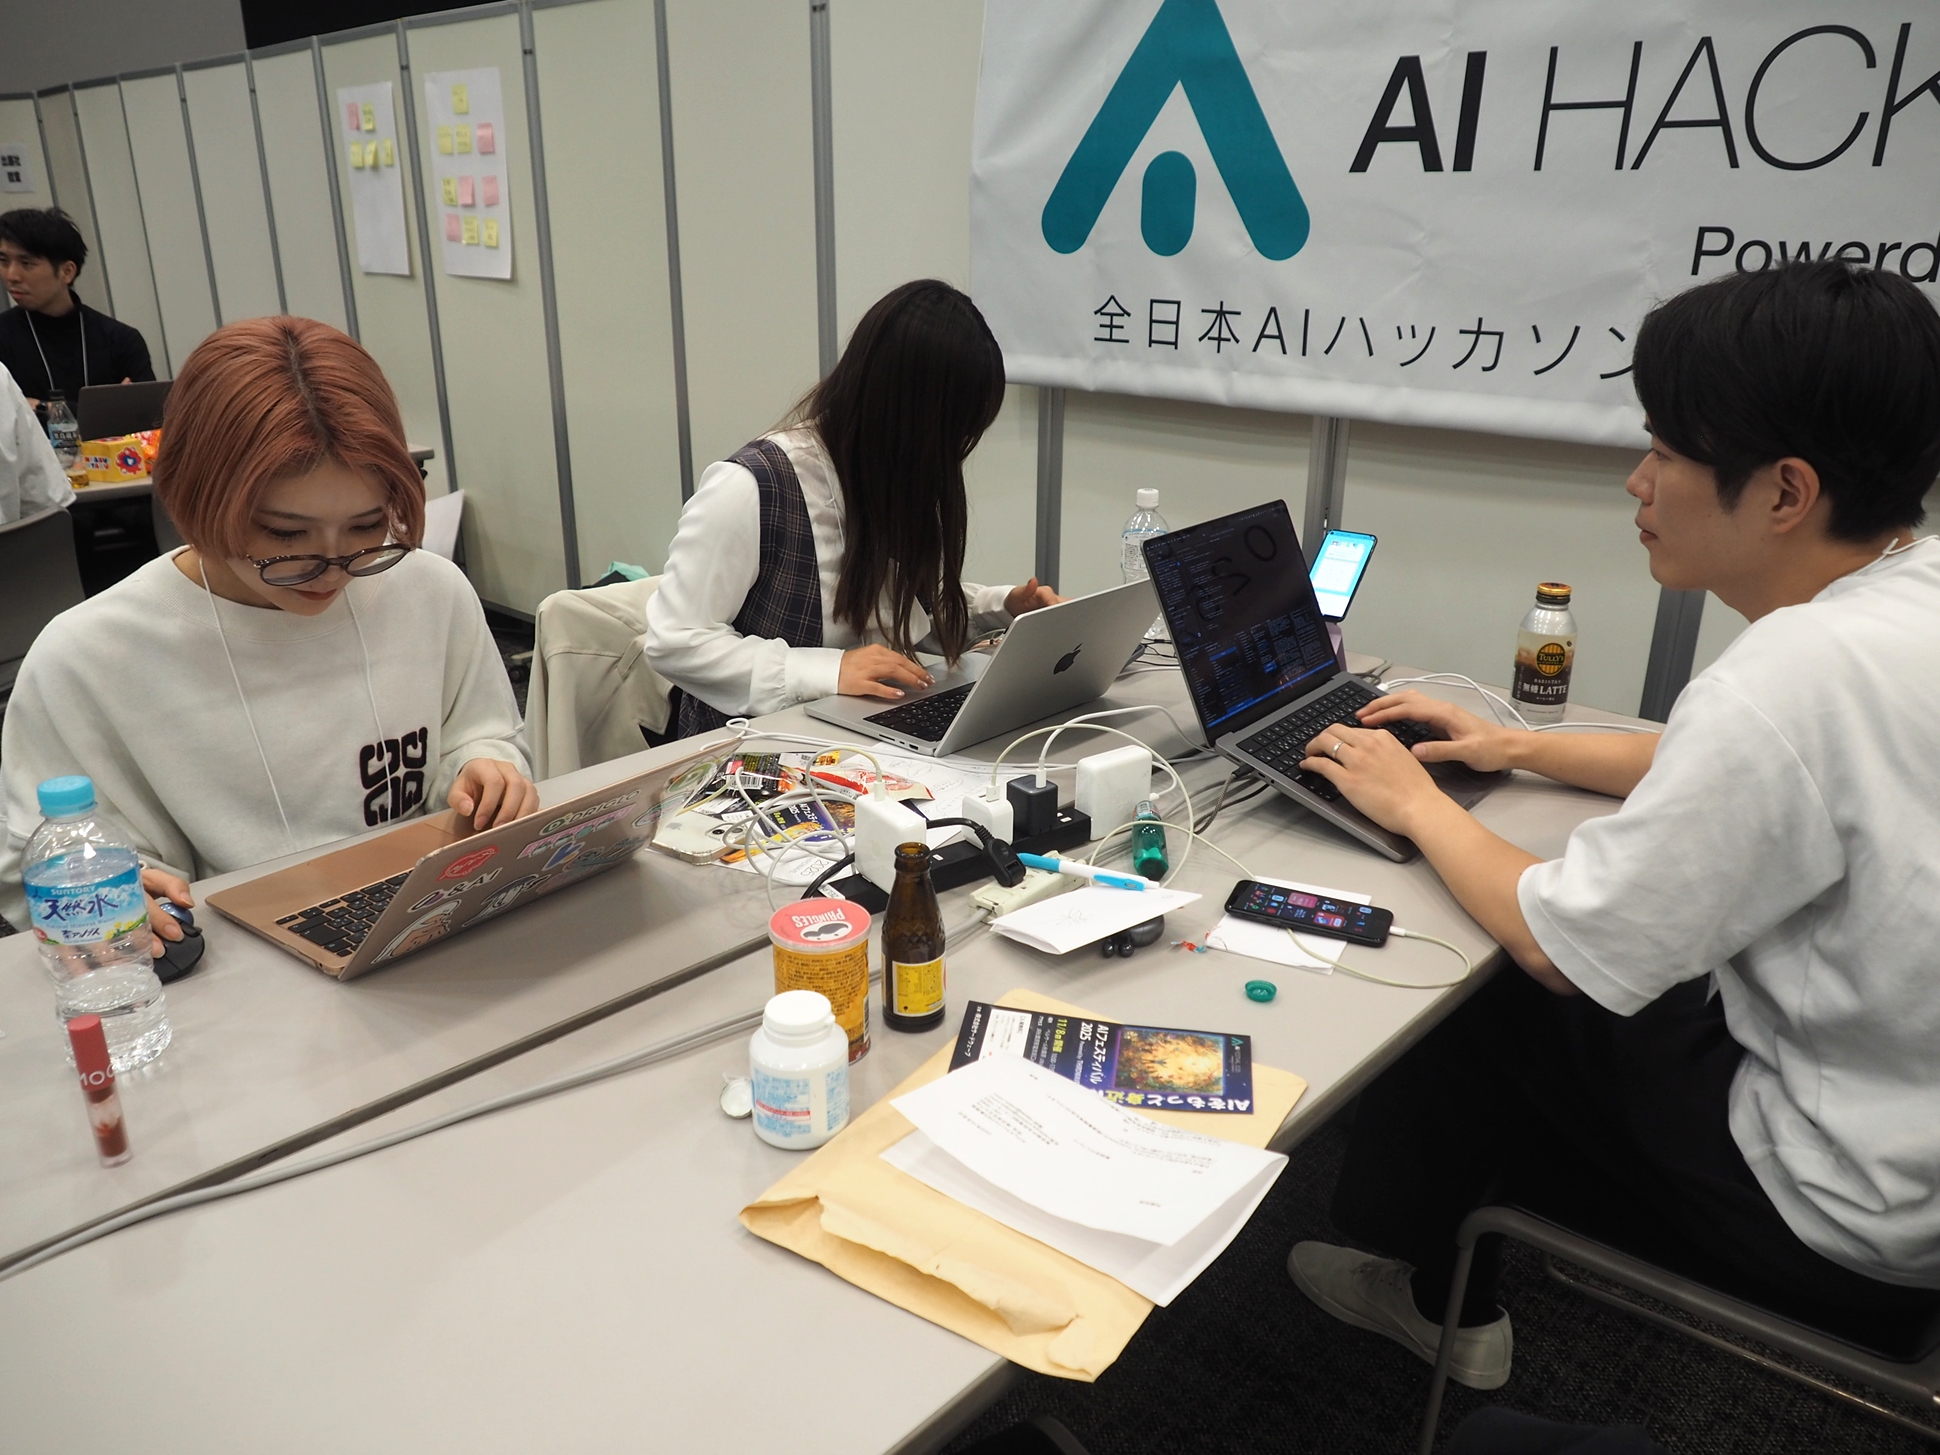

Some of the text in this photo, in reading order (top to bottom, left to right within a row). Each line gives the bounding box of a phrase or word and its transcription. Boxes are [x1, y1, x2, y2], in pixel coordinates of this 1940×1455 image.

[1350, 51, 1488, 173] AI
[50, 886, 97, 897] SUNTORY
[41, 893, 119, 922] 天然水
[791, 907, 846, 928] PRINGLES
[1080, 1022, 1093, 1041] 2025
[1090, 1024, 1109, 1085] AIフェスティバル
